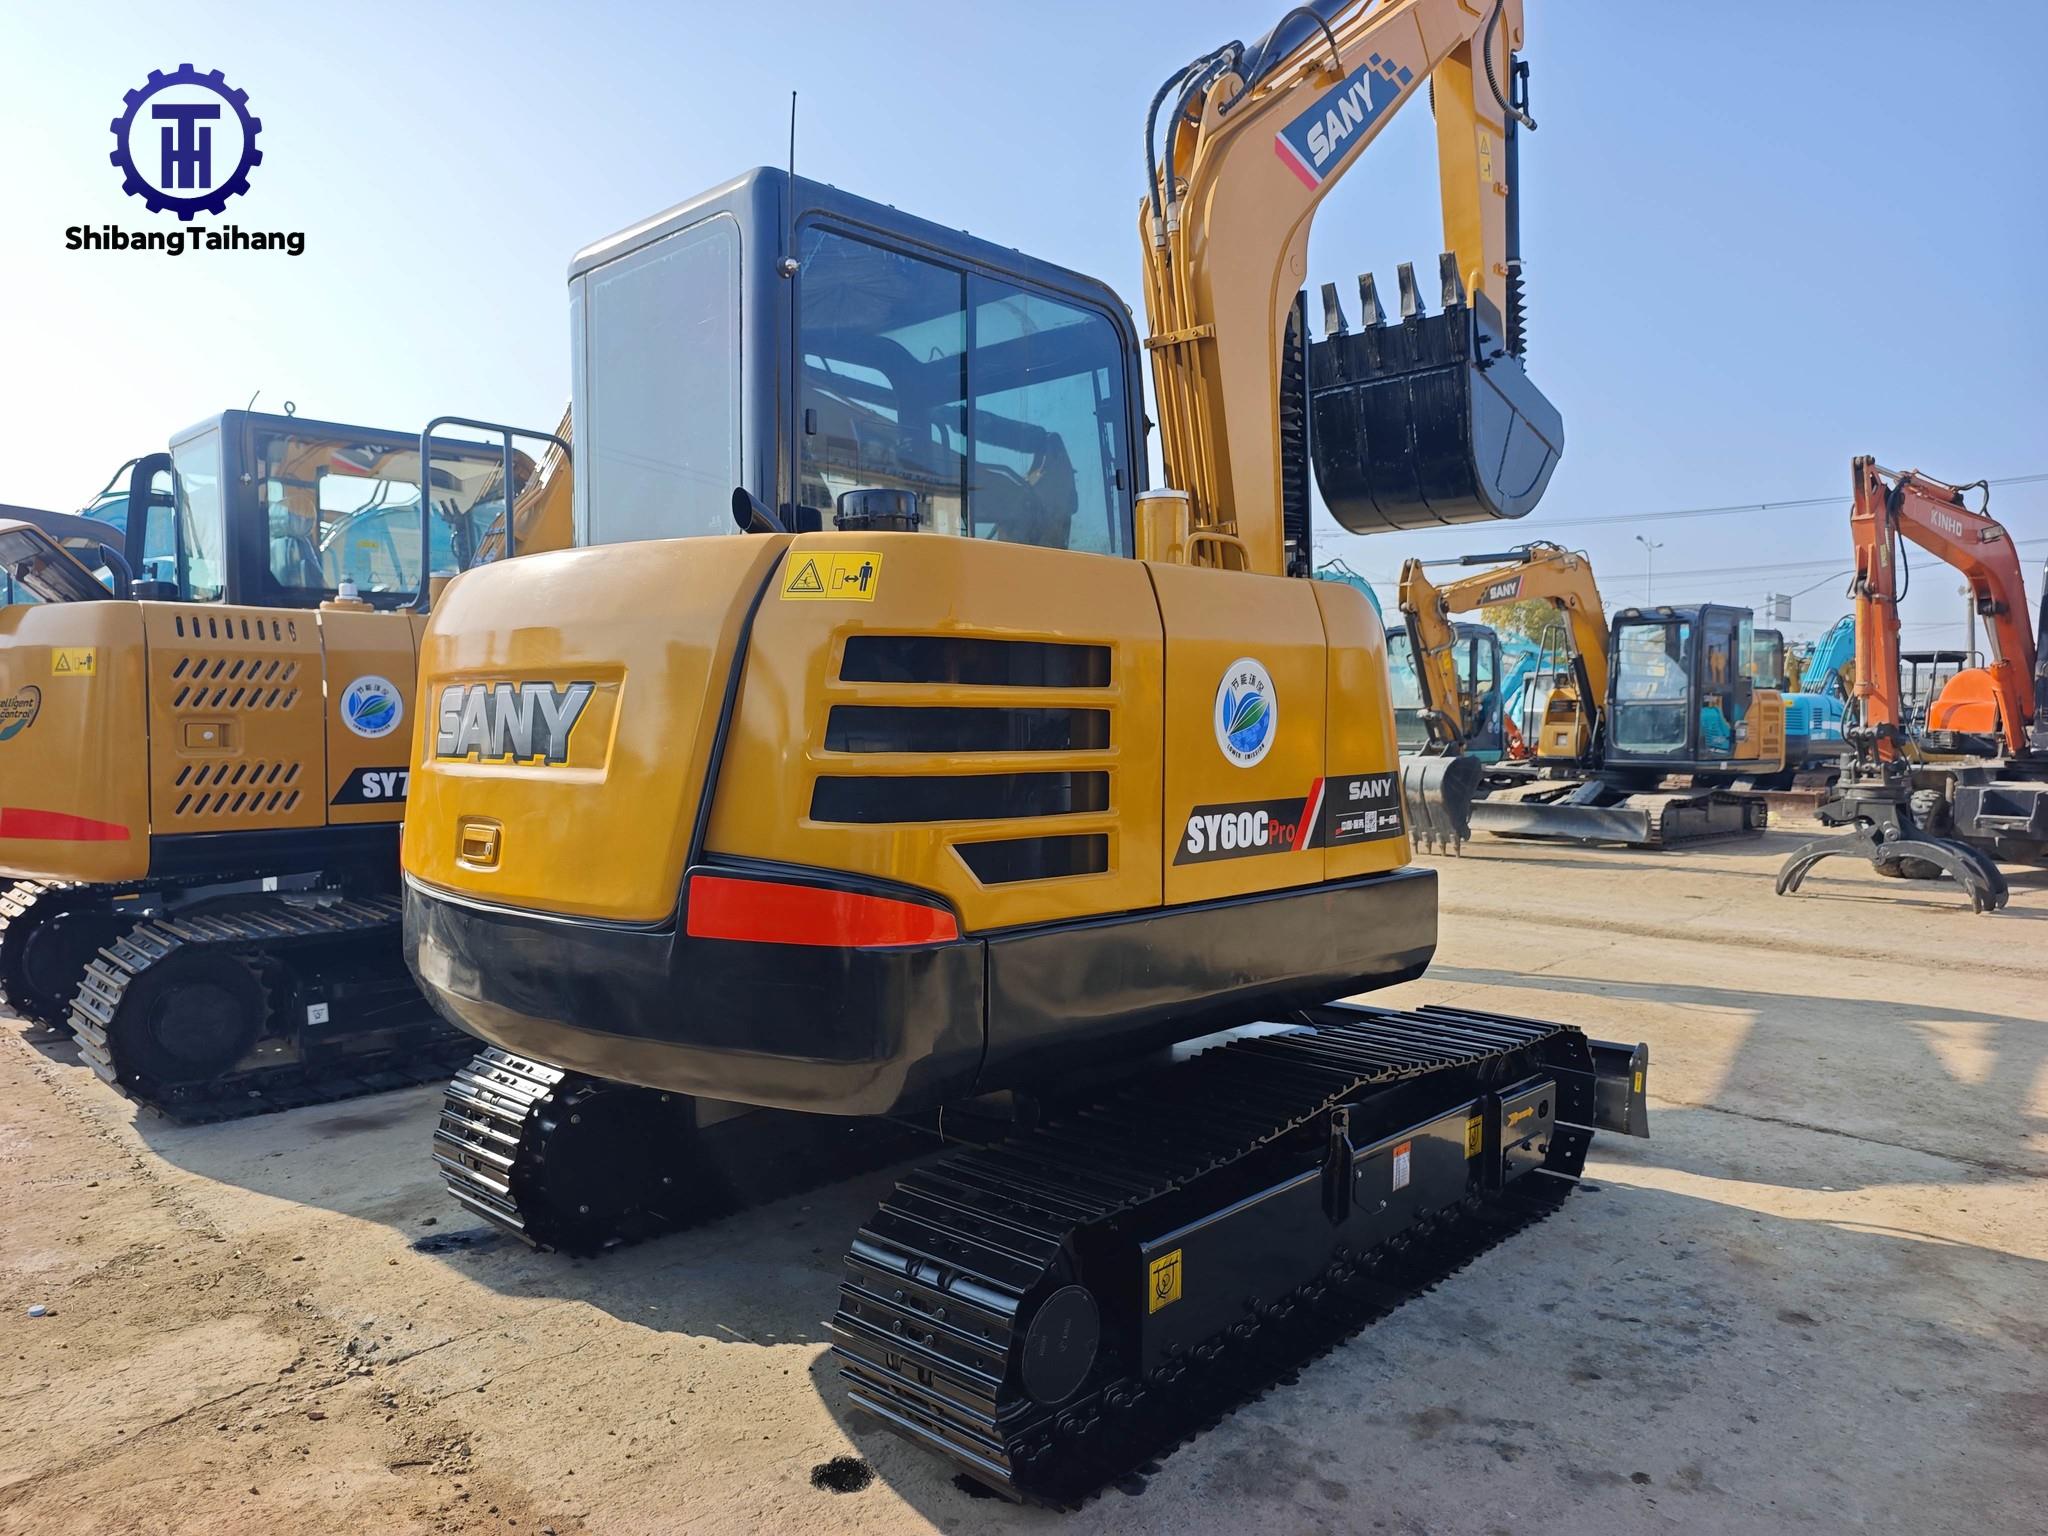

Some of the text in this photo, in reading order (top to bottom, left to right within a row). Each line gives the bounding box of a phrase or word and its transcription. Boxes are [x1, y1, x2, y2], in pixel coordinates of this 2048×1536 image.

[1307, 71, 1374, 168] SANY
[1931, 509, 1963, 537] KINHO
[1490, 582, 1517, 599] SANY
[436, 683, 595, 762] SANY
[1349, 778, 1392, 800] SANY
